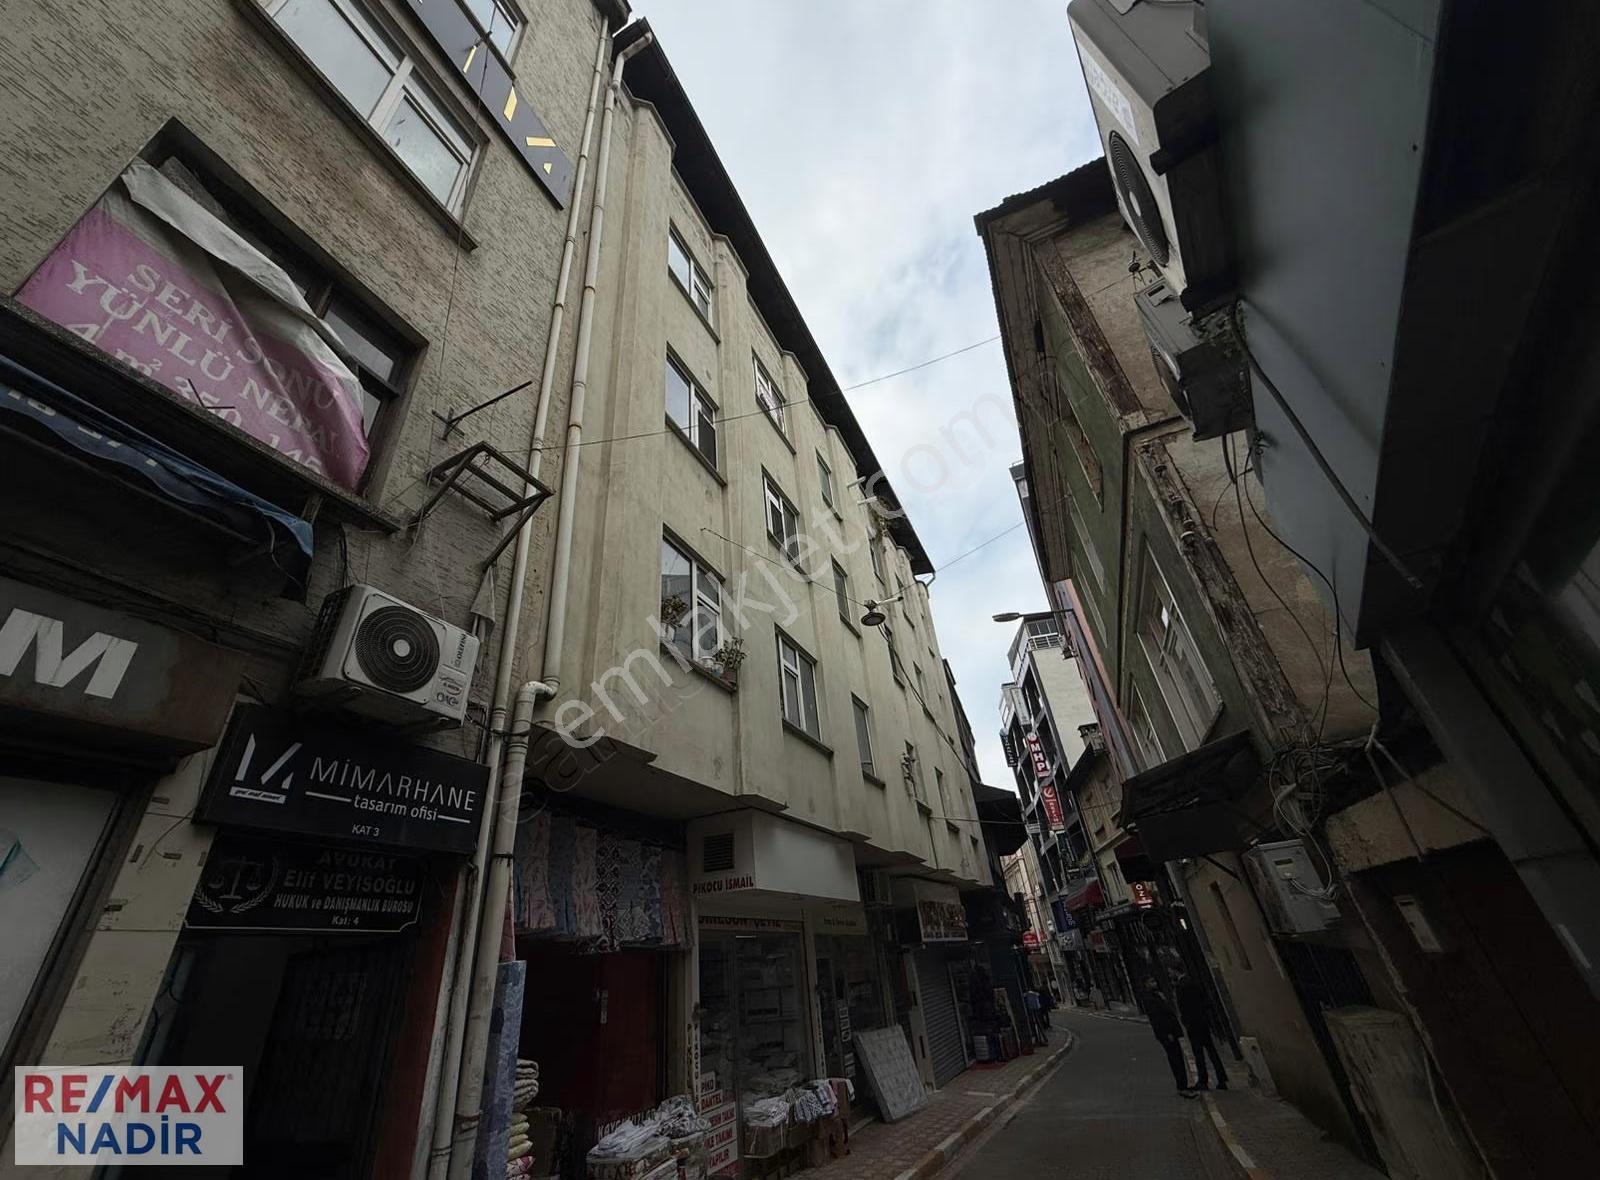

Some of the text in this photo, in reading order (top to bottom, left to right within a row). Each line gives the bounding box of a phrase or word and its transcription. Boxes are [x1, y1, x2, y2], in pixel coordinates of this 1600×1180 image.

[127, 264, 234, 344] SERİ
[66, 259, 235, 382] YÜNLÜ
[1030, 743, 1047, 772] MHP
[309, 756, 477, 812] MİMARHANE
[353, 794, 438, 821] tasarım ofisi
[352, 824, 381, 837] KAT 3
[283, 868, 317, 889] Elif
[274, 894, 312, 910] HUKUK
[312, 898, 322, 910] ve
